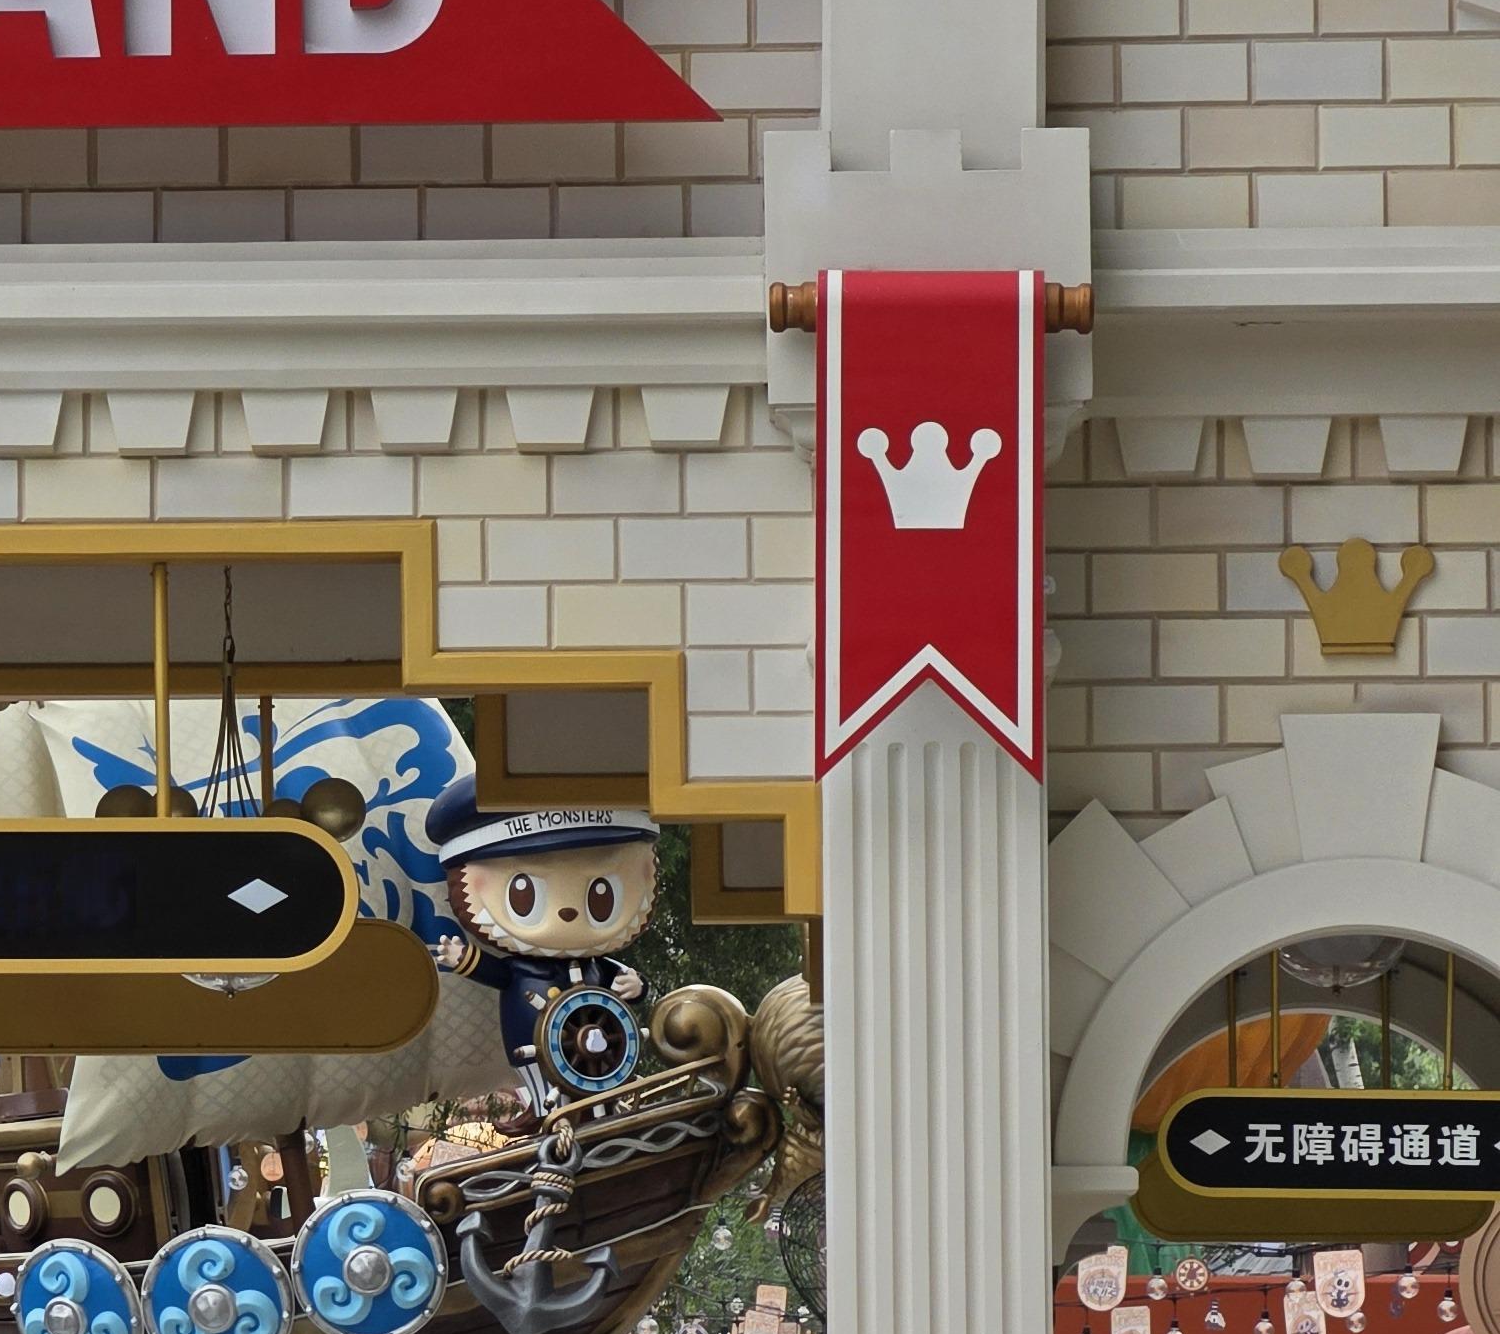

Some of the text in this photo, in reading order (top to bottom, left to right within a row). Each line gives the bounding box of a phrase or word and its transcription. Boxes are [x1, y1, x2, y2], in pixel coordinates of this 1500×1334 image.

[504, 817, 533, 836] THE
[1243, 1122, 1482, 1166] 无障碍通道
